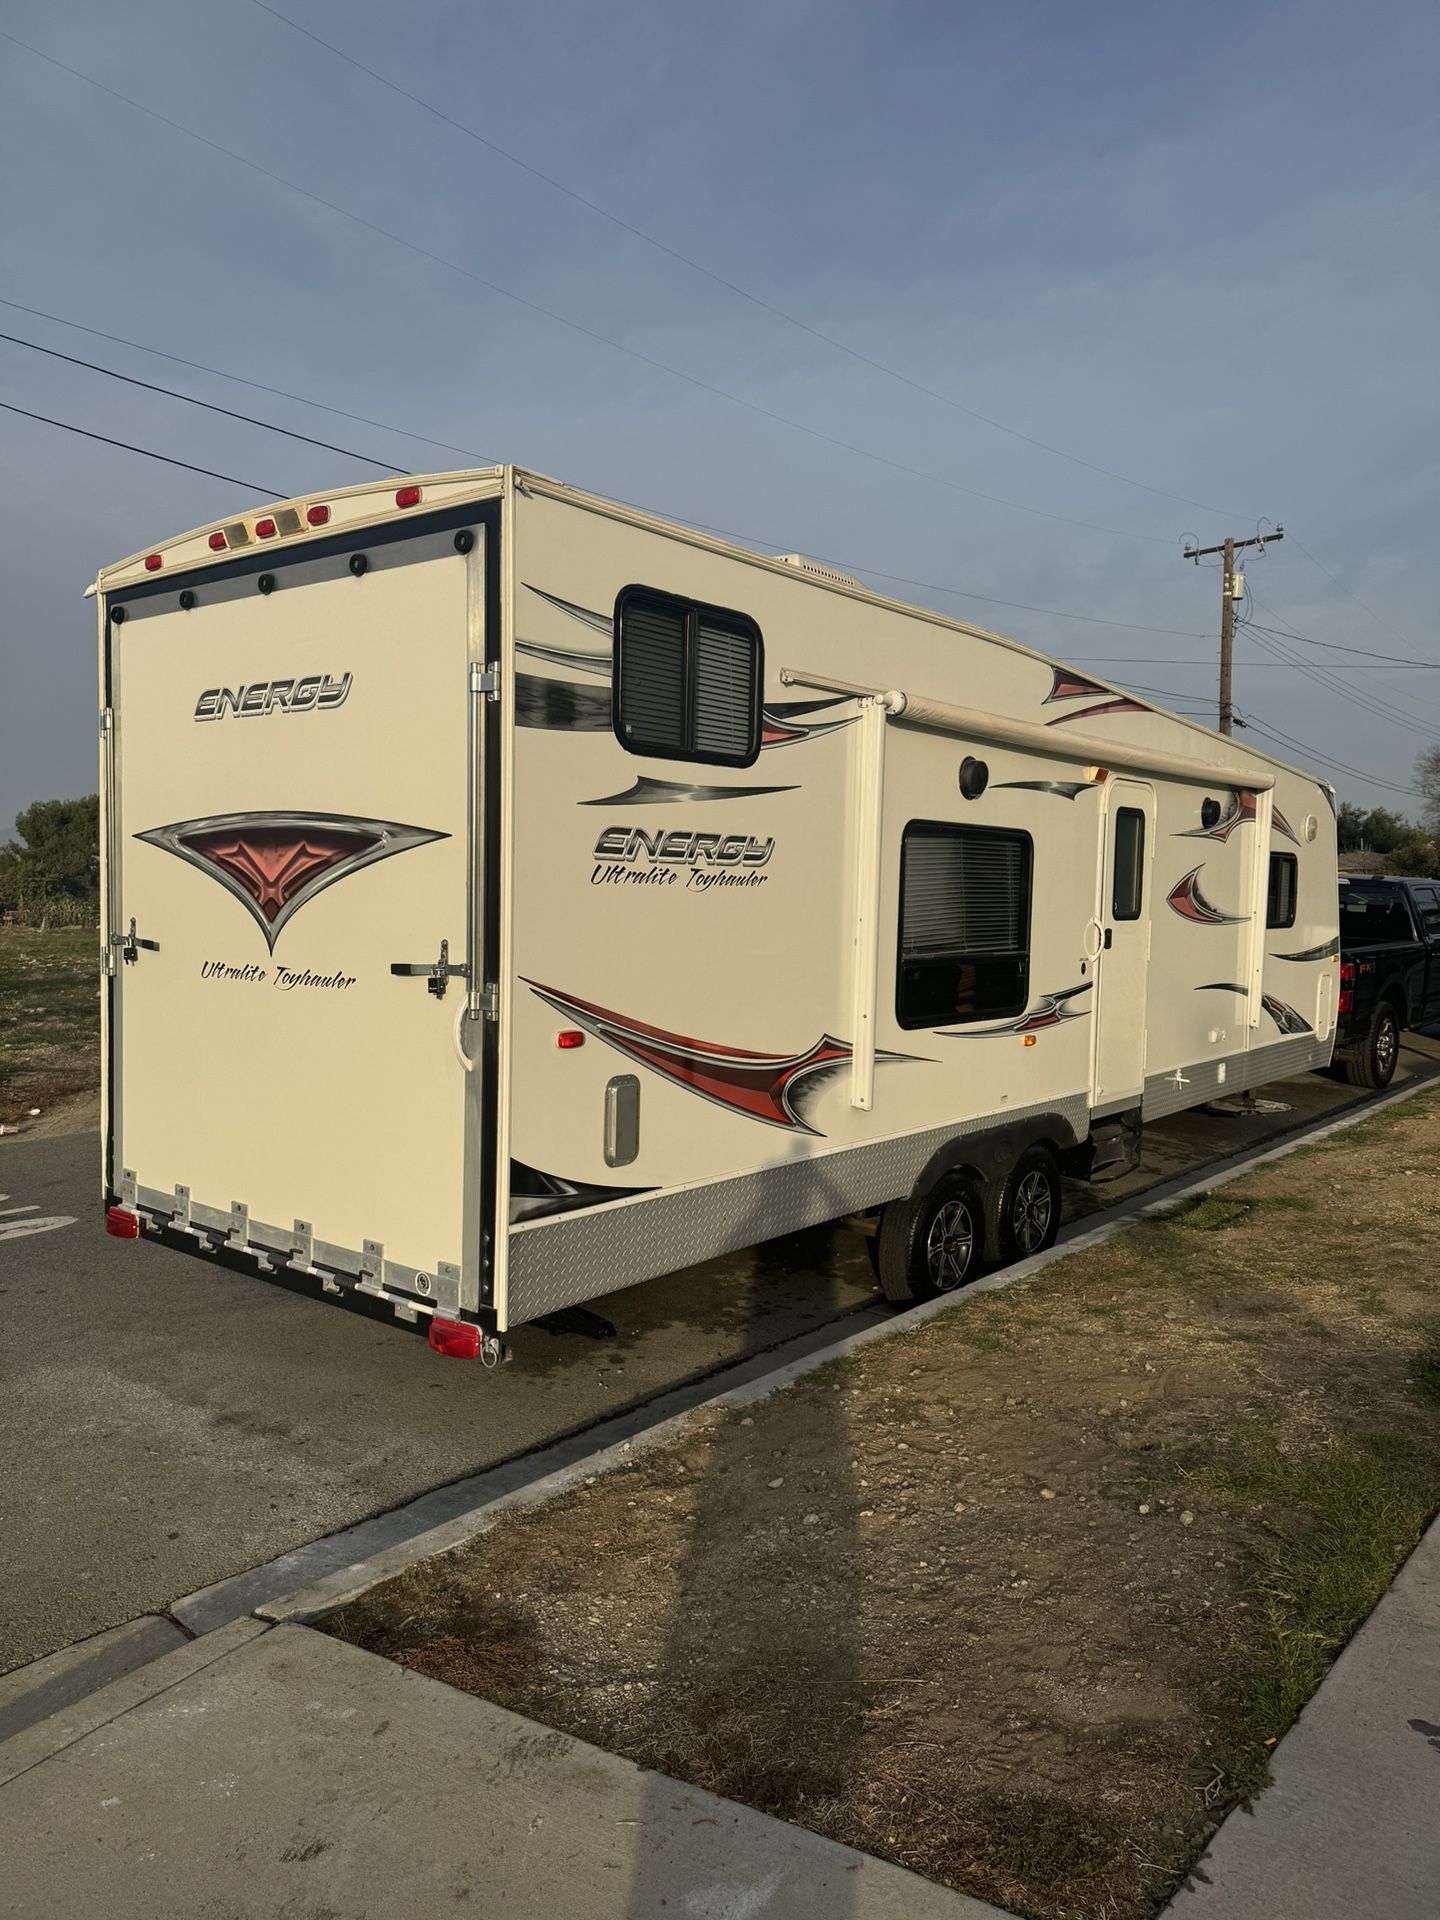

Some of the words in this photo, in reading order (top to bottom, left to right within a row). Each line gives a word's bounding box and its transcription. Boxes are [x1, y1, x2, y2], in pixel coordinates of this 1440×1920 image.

[194, 671, 353, 722] ENERGY
[592, 825, 775, 868] ENERGY
[590, 864, 679, 885] Ultralite
[686, 867, 768, 892] Toyhauler
[201, 961, 268, 982] Ultralite
[273, 966, 356, 991] Toyhauler
